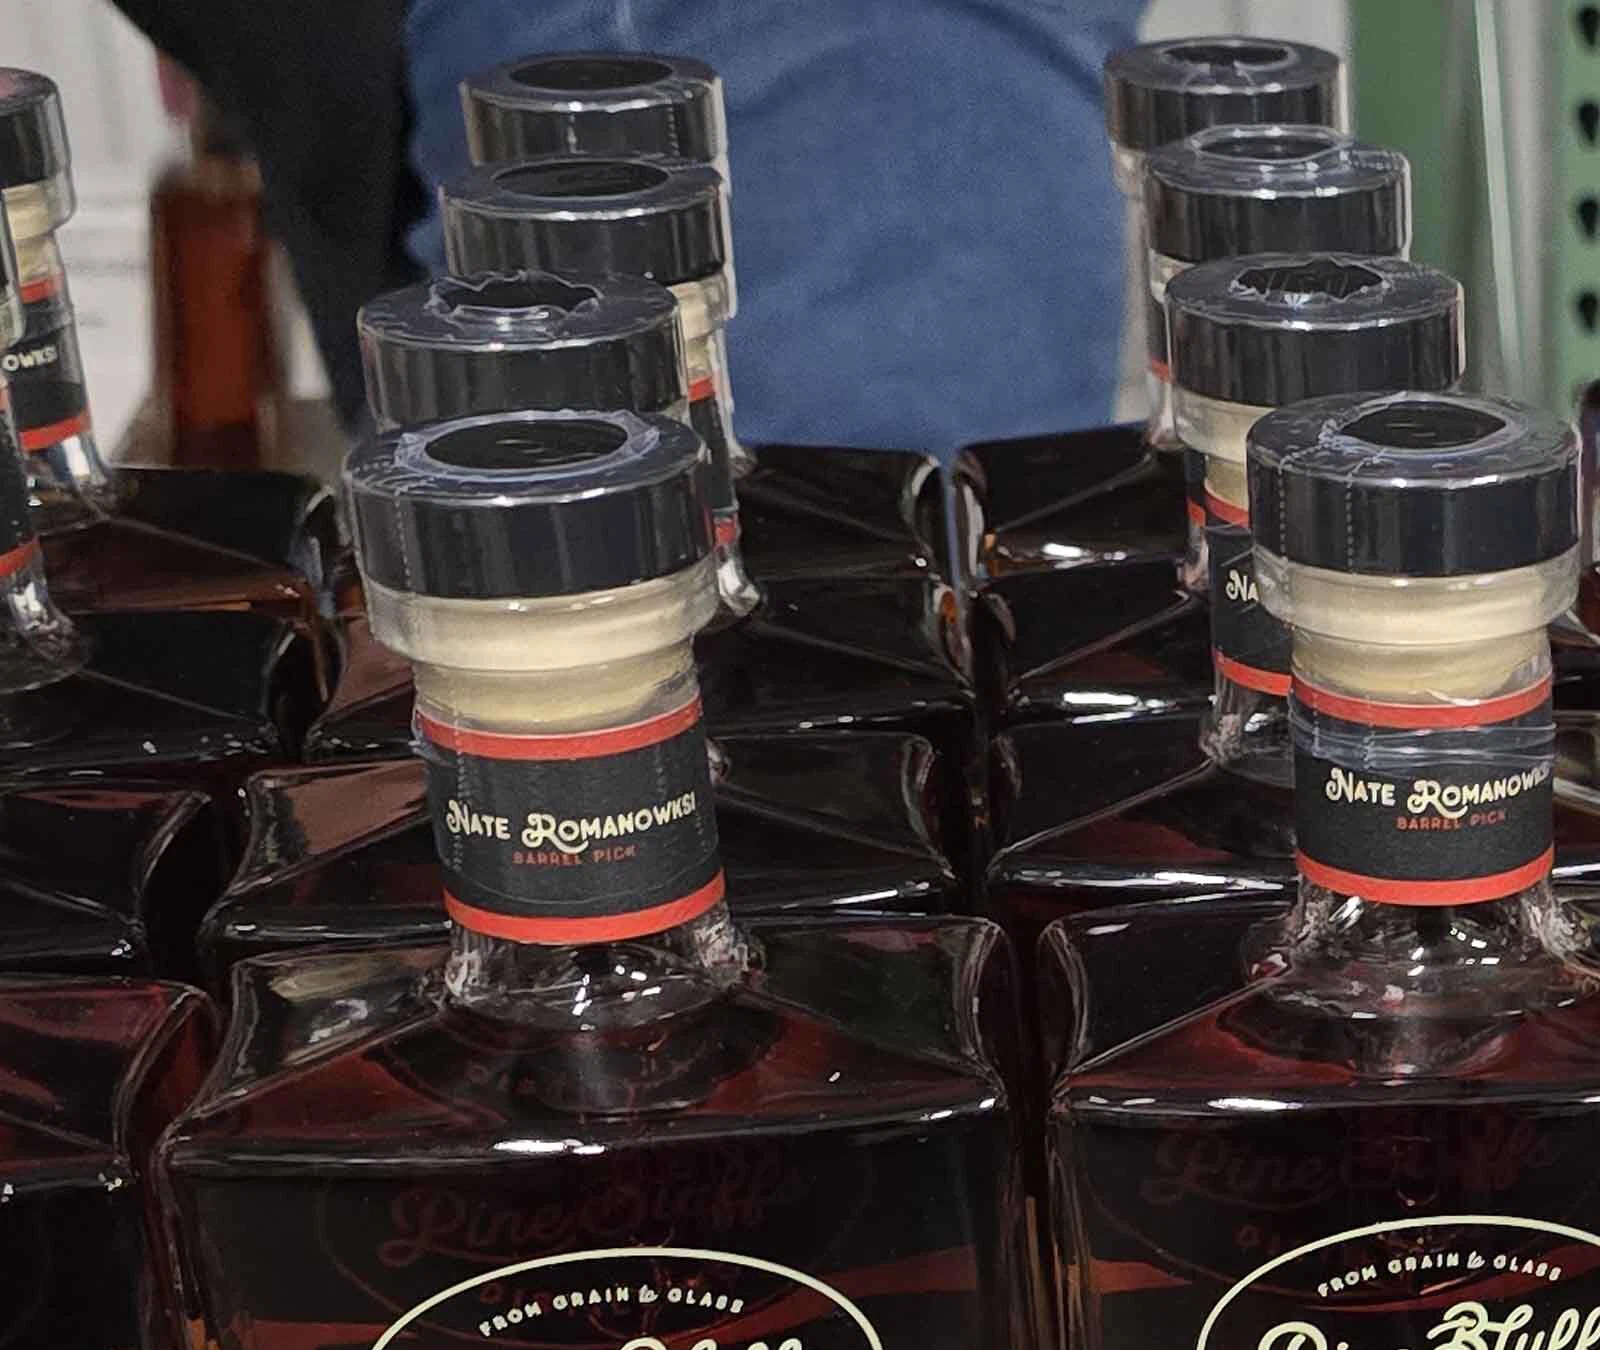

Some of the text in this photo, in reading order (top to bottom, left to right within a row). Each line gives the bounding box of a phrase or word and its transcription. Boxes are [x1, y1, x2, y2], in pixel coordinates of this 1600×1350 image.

[1226, 569, 1259, 602] NA
[1326, 767, 1396, 806] NATE
[446, 799, 511, 840] NATE
[1396, 816, 1462, 831] BARREL
[512, 844, 637, 866] BARREL PICK
[1318, 1265, 1377, 1297] FROM
[1388, 1253, 1459, 1274] GRAIN
[479, 1302, 542, 1336] FROM
[552, 1286, 630, 1310] GRAIN
